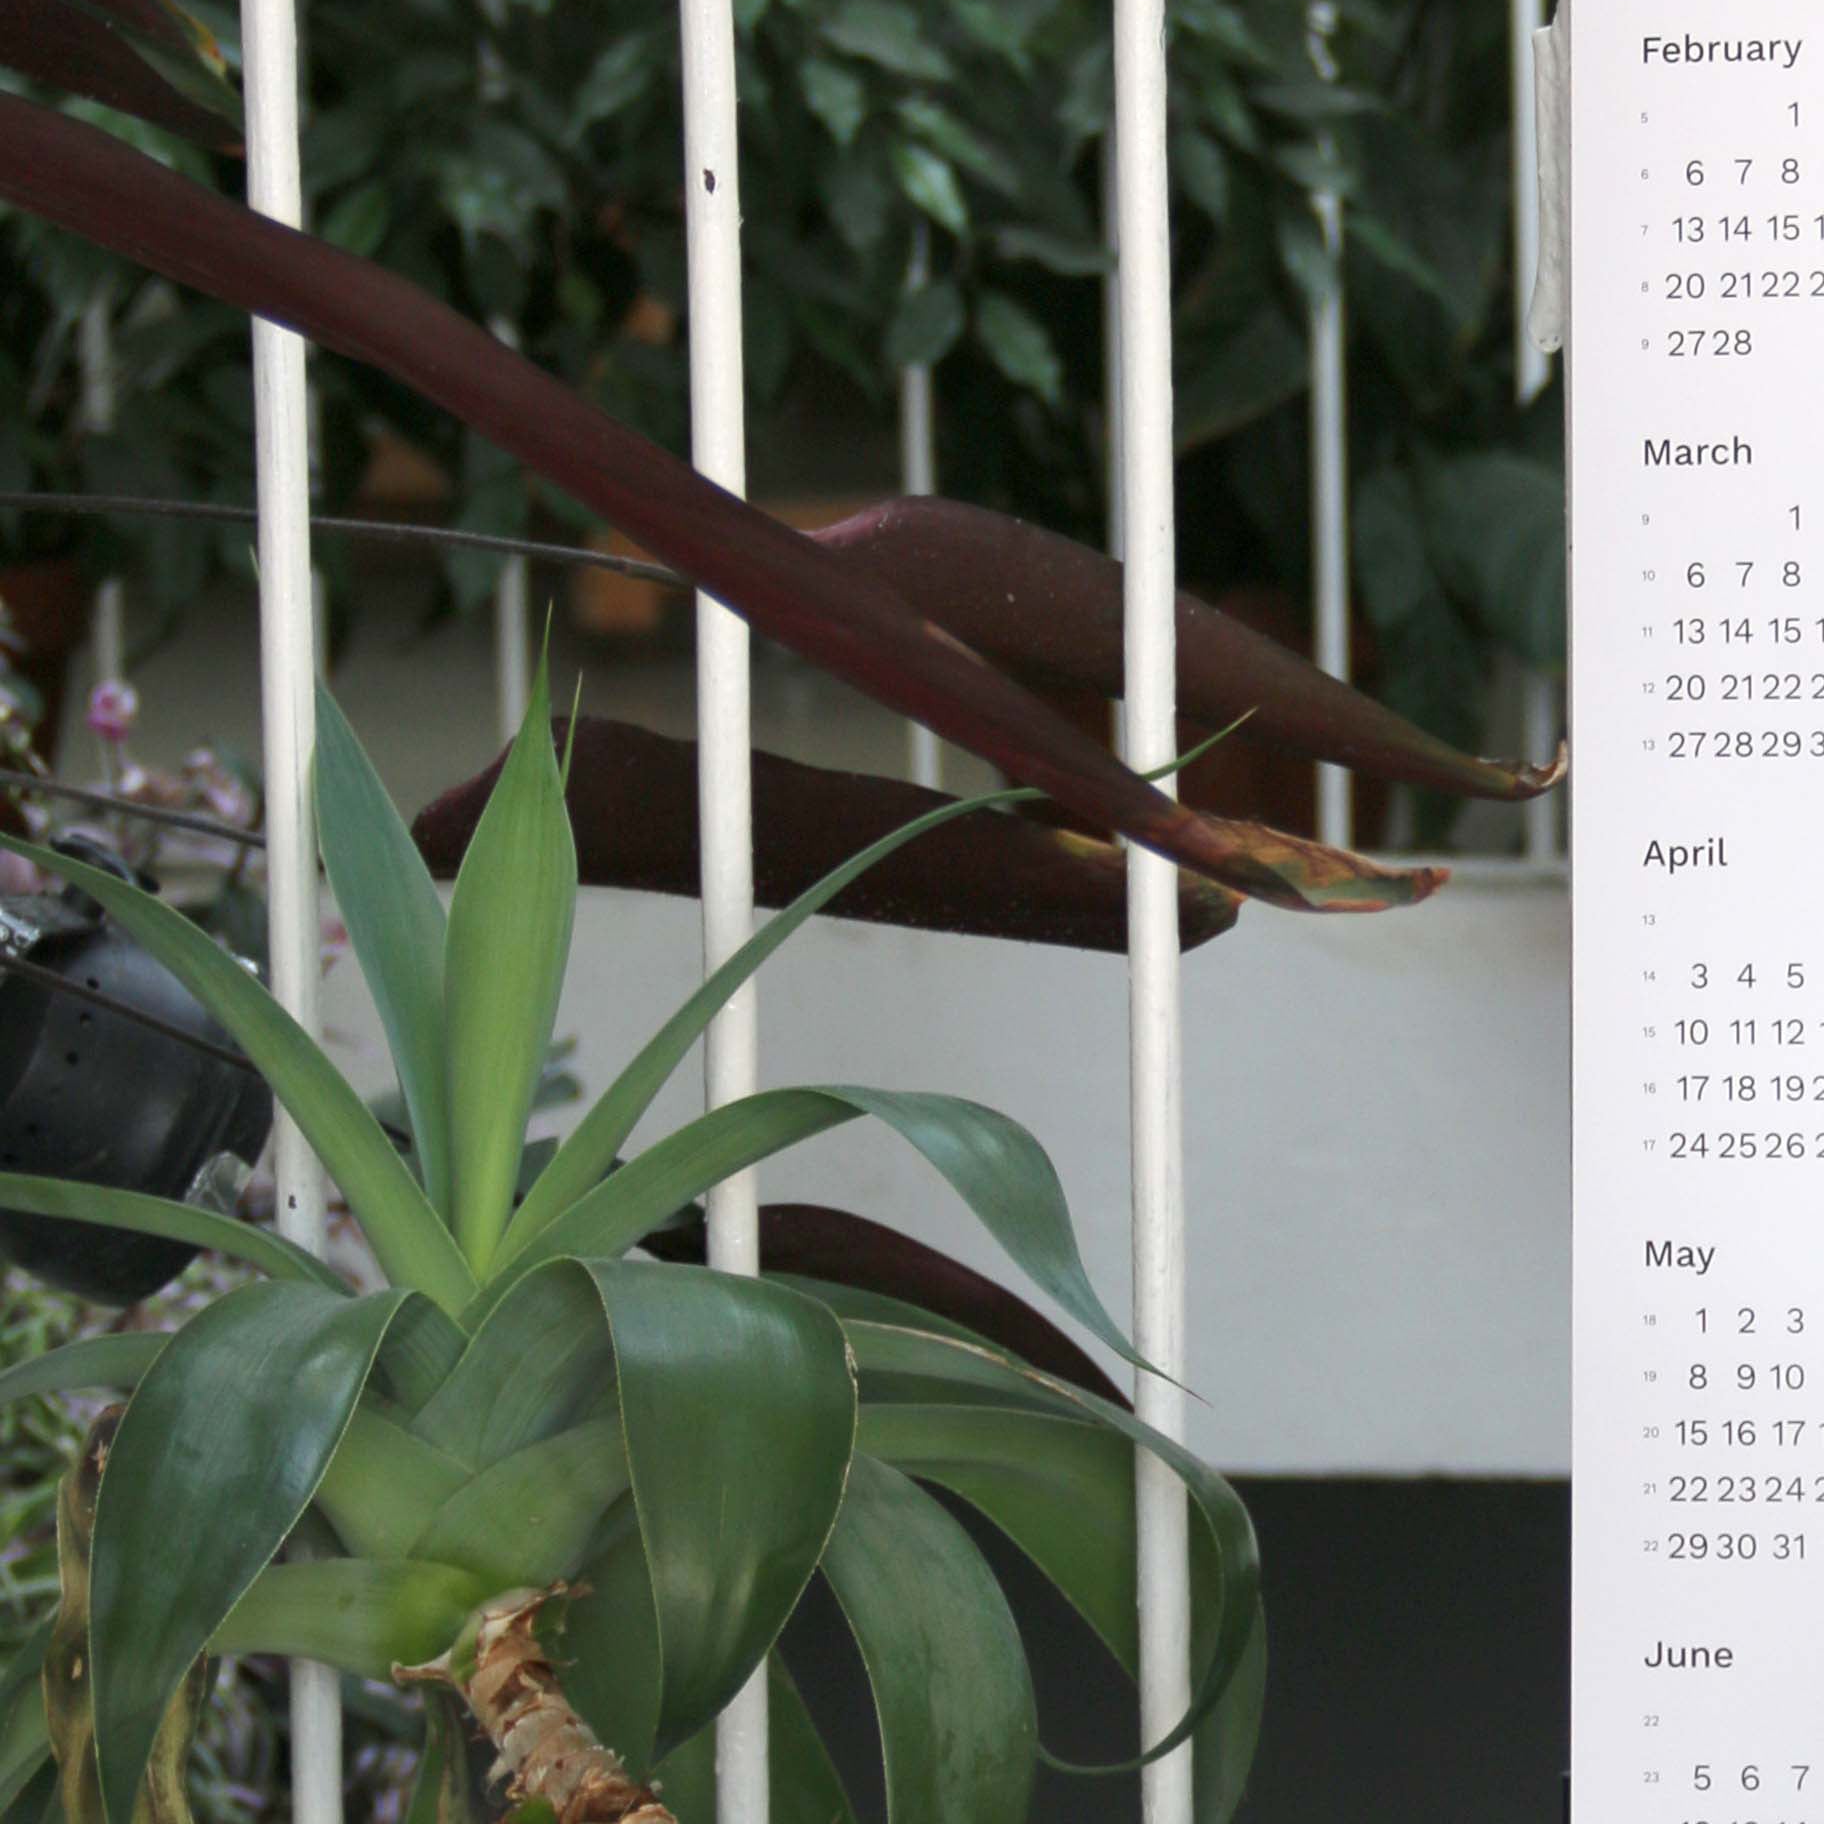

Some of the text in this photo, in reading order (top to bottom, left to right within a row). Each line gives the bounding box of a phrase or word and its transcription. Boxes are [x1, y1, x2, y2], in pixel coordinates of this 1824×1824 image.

[1644, 34, 1801, 68] February
[1788, 102, 1798, 127] 1
[1673, 217, 1704, 242] 13
[1719, 216, 1752, 241] 14
[1768, 215, 1800, 240] 15
[1668, 331, 1705, 356] 27
[1713, 330, 1752, 355] 28
[1645, 436, 1751, 465] March
[1789, 505, 1800, 530] 1
[1687, 562, 1705, 588] 6
[1736, 562, 1754, 587] 7
[1783, 561, 1800, 587] 8
[1669, 732, 1706, 757] 27
[1714, 732, 1753, 757] 28
[1762, 731, 1801, 757] 29
[1643, 838, 1727, 874] April
[1675, 1019, 1708, 1045] 10
[1730, 1020, 1755, 1044] 11
[1772, 1019, 1804, 1044] 12
[1670, 1133, 1709, 1158] 24
[1718, 1133, 1756, 1158] 25
[1765, 1133, 1805, 1158] 26
[1646, 1241, 1715, 1275] May
[1696, 1308, 1706, 1334] 1
[1738, 1308, 1755, 1333] 2
[1787, 1308, 1804, 1334] 3
[1675, 1420, 1707, 1446] 15
[1722, 1420, 1756, 1446] 16
[1773, 1421, 1805, 1446] 17
[1668, 1533, 1708, 1559] 29
[1717, 1534, 1756, 1559] 30
[1773, 1534, 1804, 1559] 31
[1645, 1641, 1733, 1668] June
[1694, 1765, 1711, 1791] 5
[1741, 1765, 1760, 1791] 6
[1791, 1765, 1810, 1791] 7
